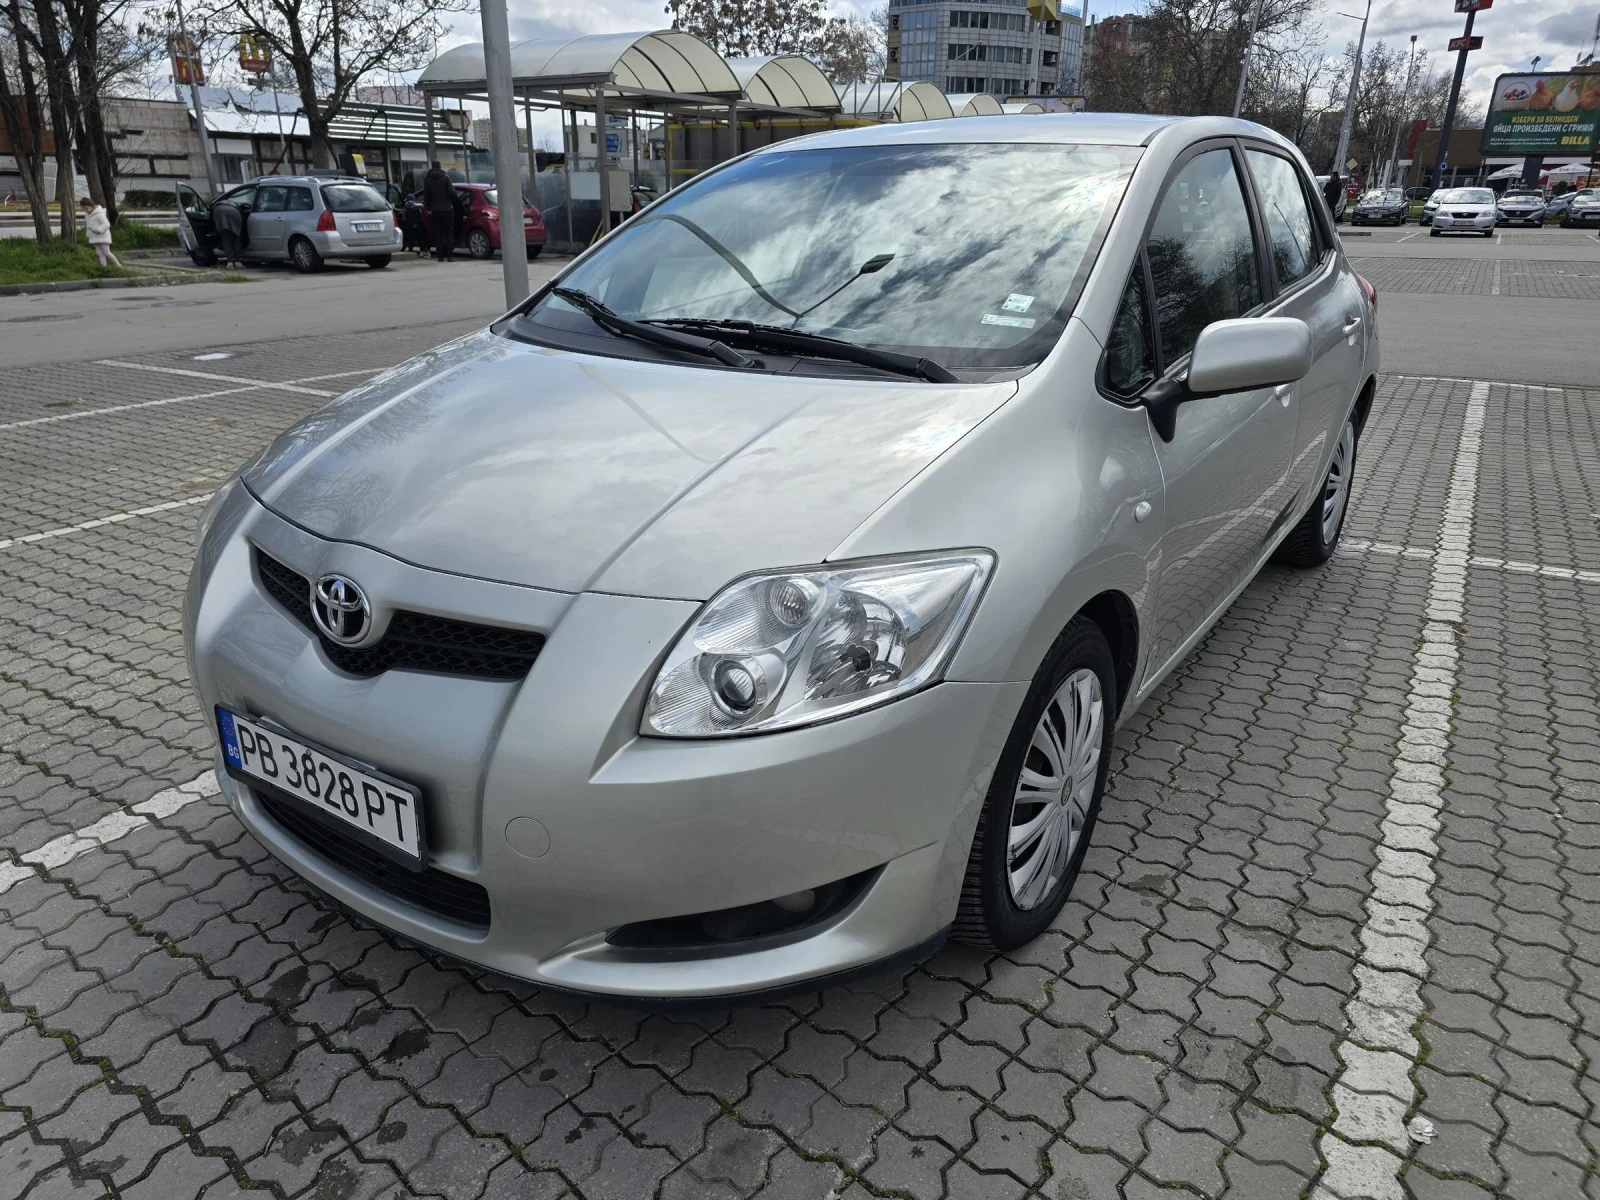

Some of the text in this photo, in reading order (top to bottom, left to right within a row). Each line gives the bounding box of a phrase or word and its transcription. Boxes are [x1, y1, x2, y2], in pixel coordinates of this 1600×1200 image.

[1450, 39, 1467, 48] KFC
[1493, 123, 1594, 133] ЯЙЦА ПРОИЗВЕДЕНИ С ГРИЖА
[1561, 136, 1590, 145] BILLA
[227, 743, 239, 759] BG
